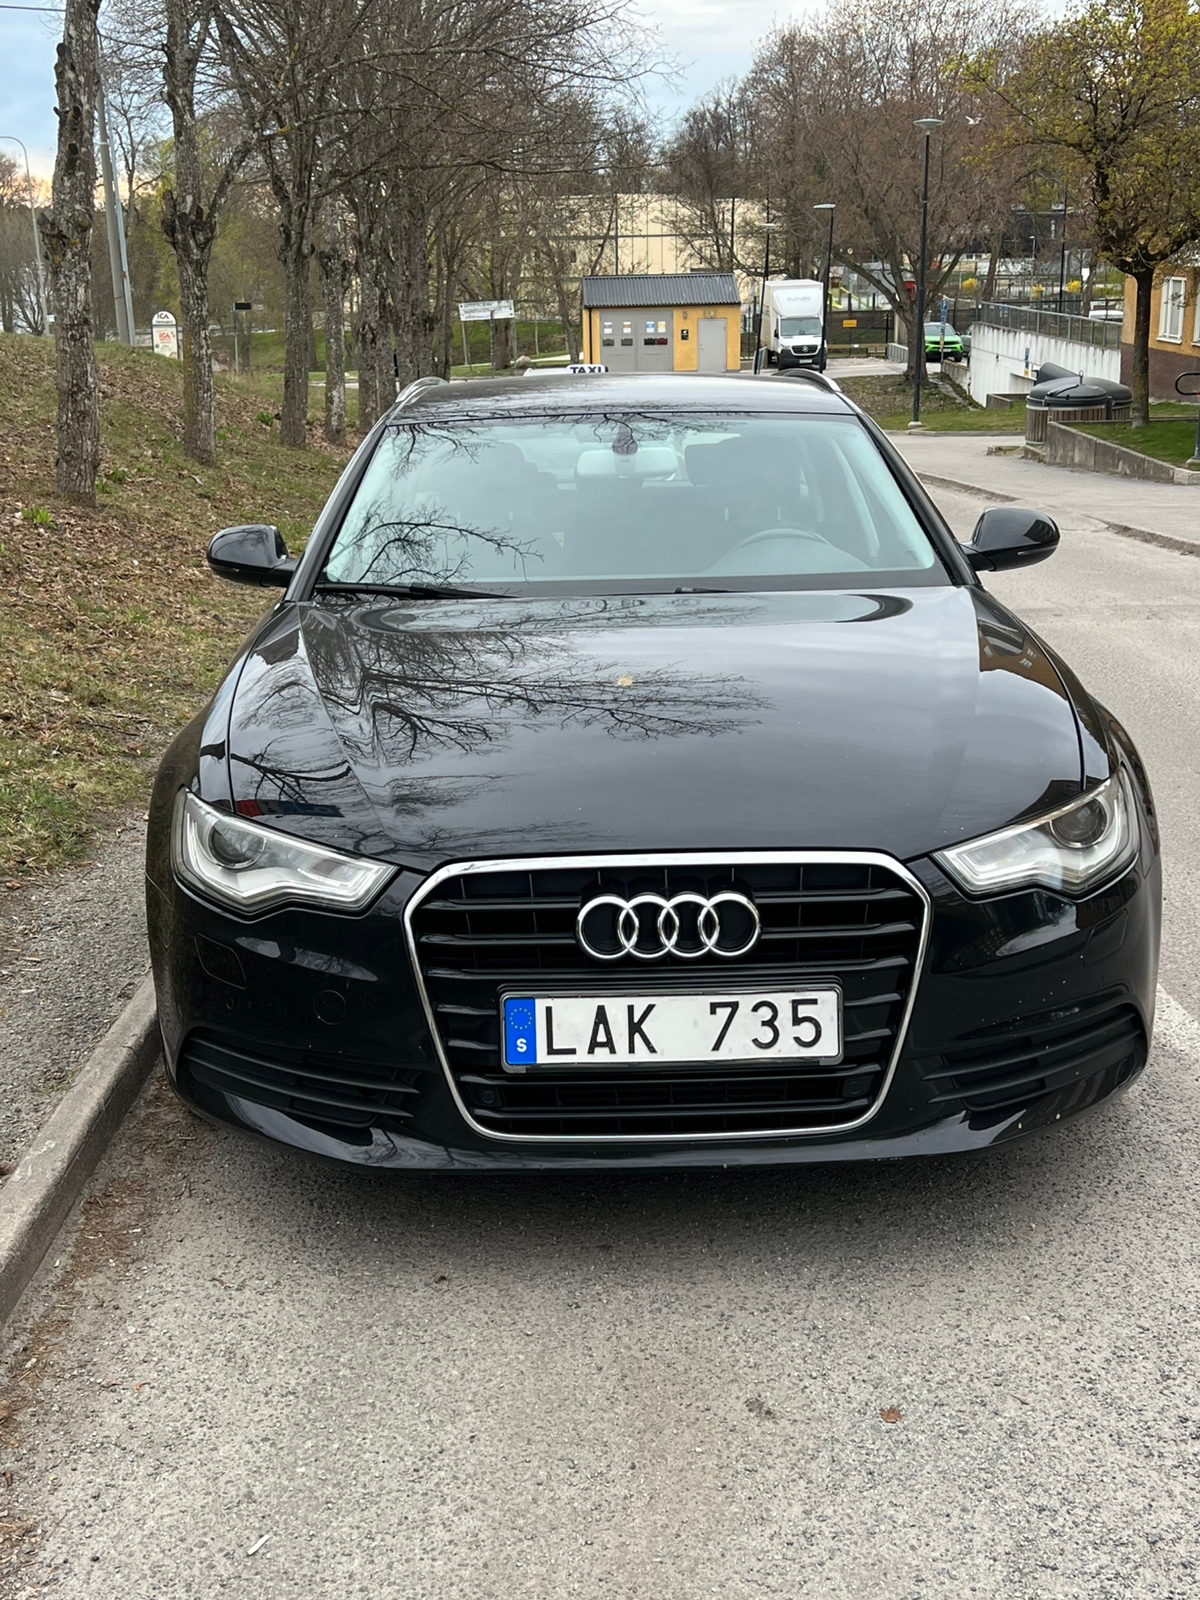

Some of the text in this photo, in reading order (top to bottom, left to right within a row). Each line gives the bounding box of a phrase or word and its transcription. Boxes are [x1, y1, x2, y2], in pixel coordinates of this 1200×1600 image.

[570, 366, 602, 374] TAXI
[545, 998, 822, 1056] LAK 735
[516, 1037, 527, 1052] S
